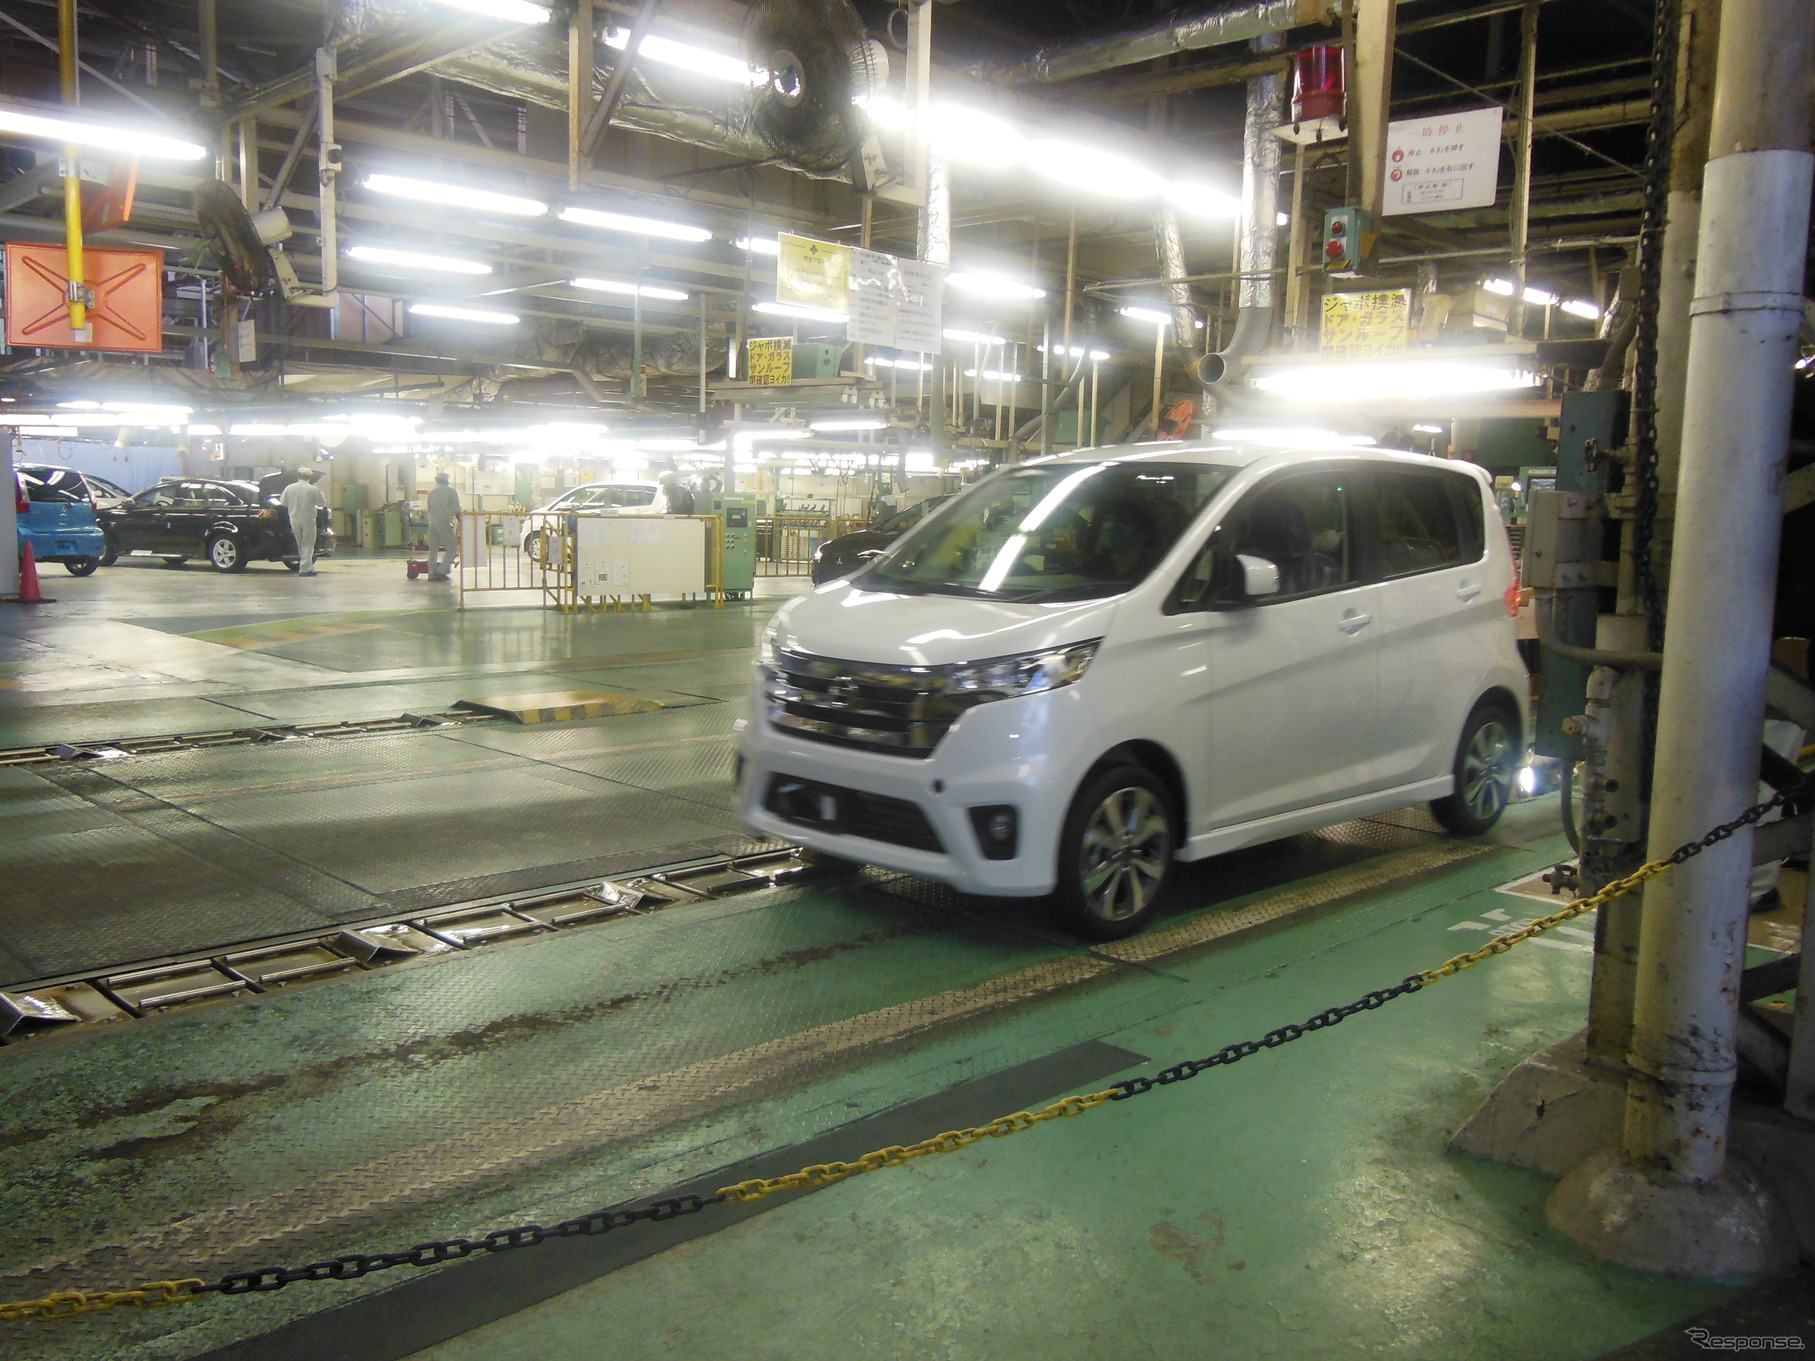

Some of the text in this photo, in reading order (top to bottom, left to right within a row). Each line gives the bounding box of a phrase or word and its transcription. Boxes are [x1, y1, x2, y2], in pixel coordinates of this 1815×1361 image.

[1324, 310, 1405, 328] ドア・ガラス
[1323, 326, 1405, 344] サンルーフ
[750, 351, 790, 362] ドア・ガラス
[750, 362, 790, 374] サンルーフ
